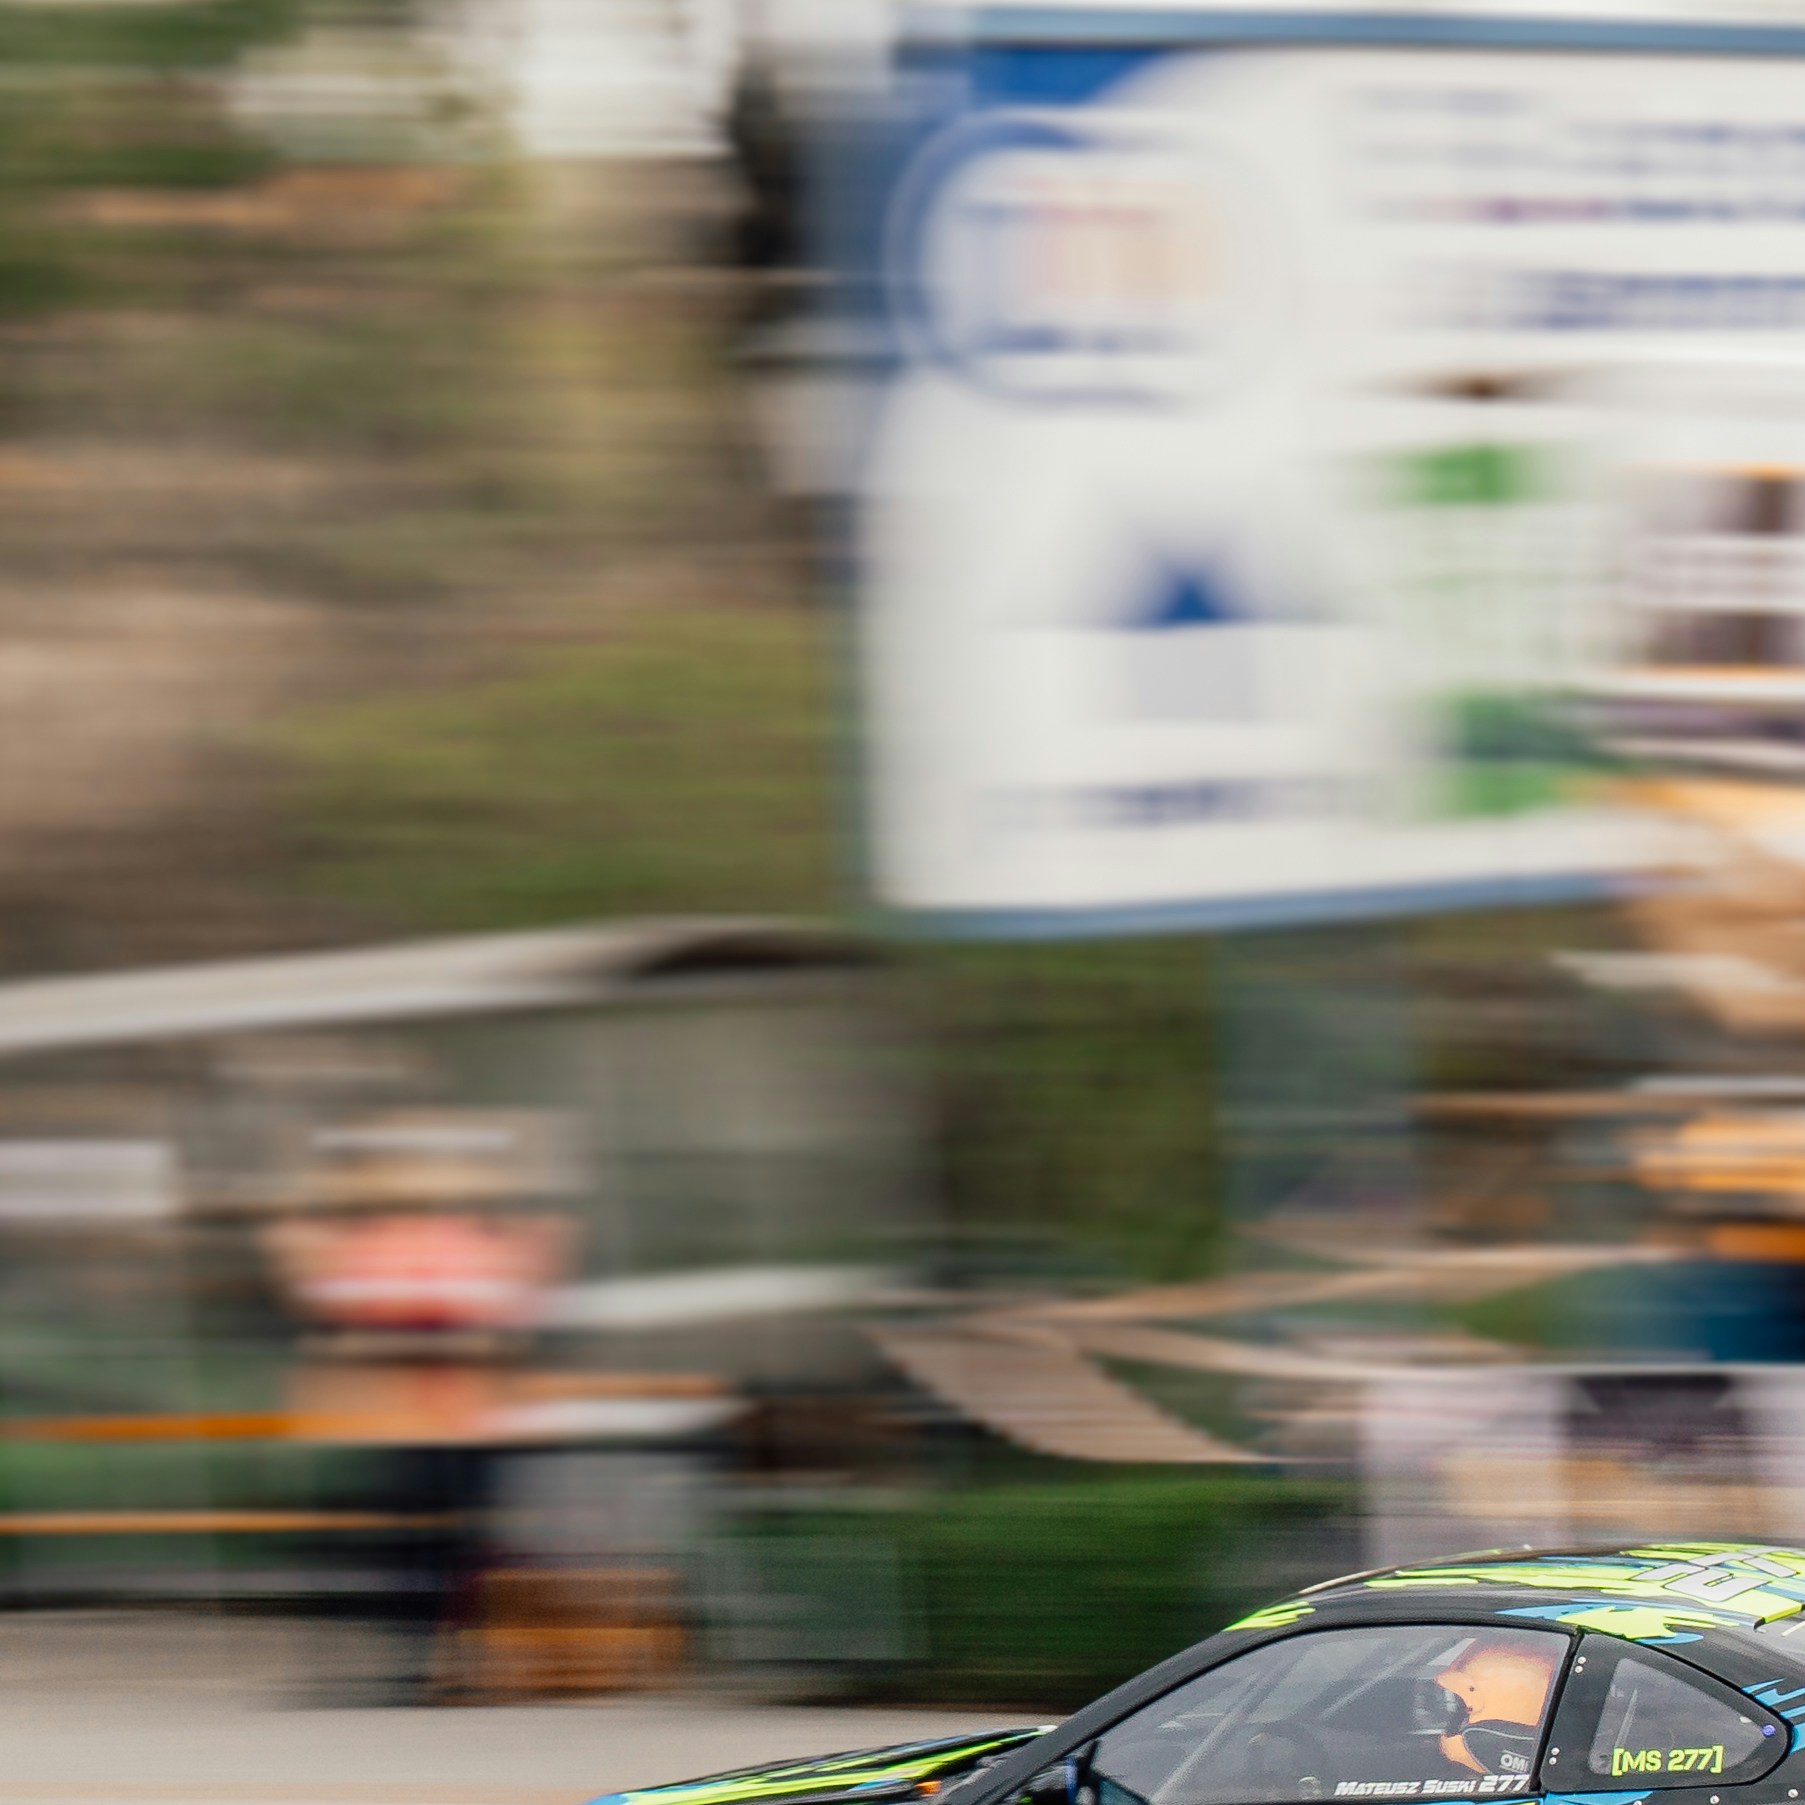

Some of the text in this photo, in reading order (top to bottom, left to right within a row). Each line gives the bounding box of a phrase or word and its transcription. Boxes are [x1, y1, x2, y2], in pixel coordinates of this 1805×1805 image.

[1611, 1744, 1724, 1777] [MS 277]
[1478, 1774, 1530, 1793] 277
